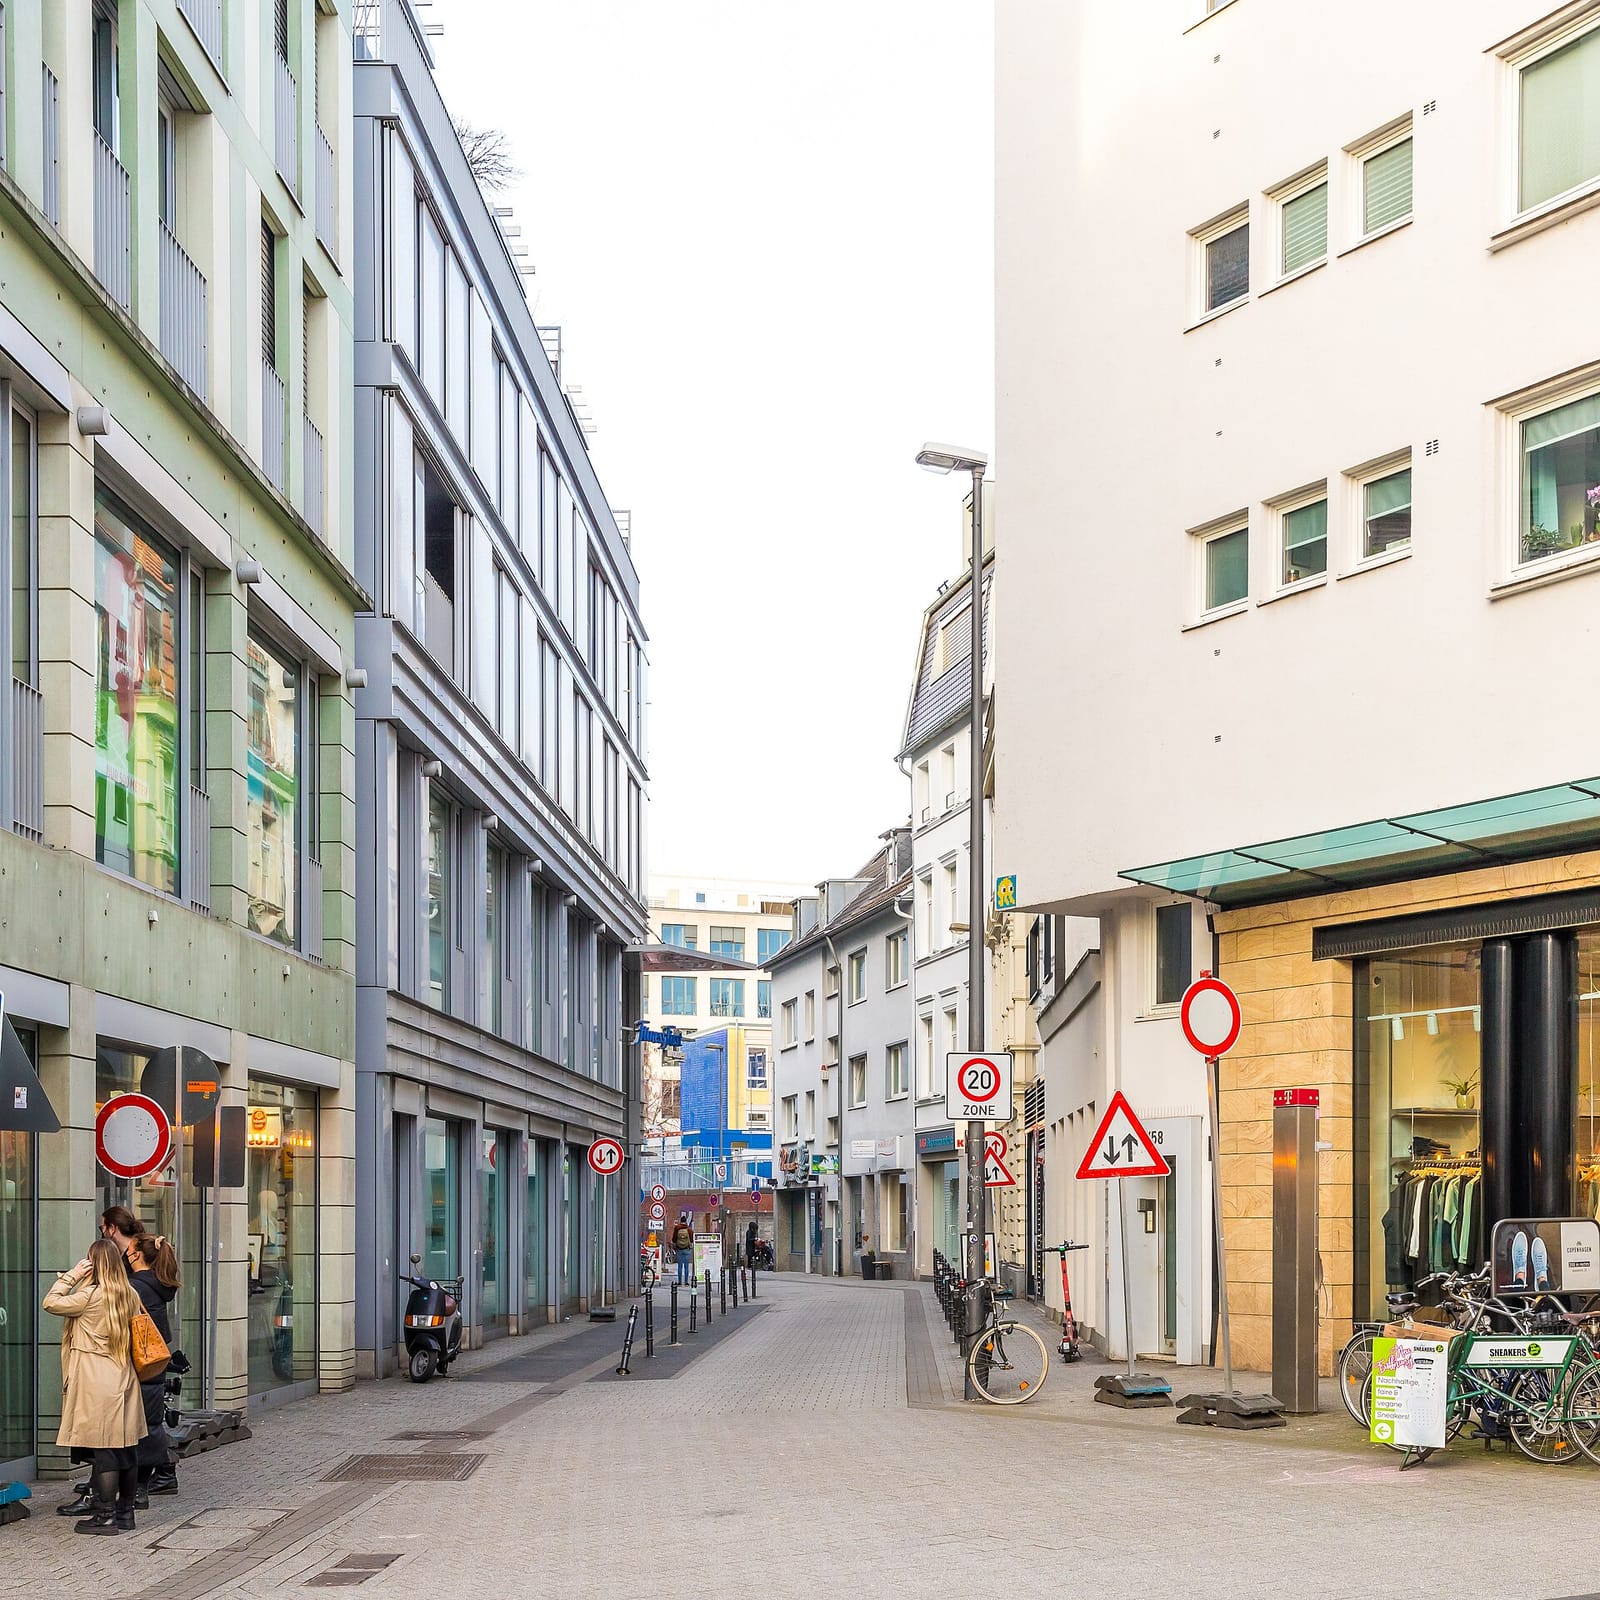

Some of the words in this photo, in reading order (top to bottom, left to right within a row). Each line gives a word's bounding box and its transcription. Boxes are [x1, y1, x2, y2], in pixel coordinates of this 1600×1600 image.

[968, 1070, 991, 1089] 20
[1284, 1090, 1293, 1104] T
[963, 1105, 995, 1115] ZONE
[1489, 1348, 1527, 1357] SNEAKERS
[1378, 1377, 1420, 1387] Nachhaltige,
[1377, 1412, 1410, 1420] Sneakers!
